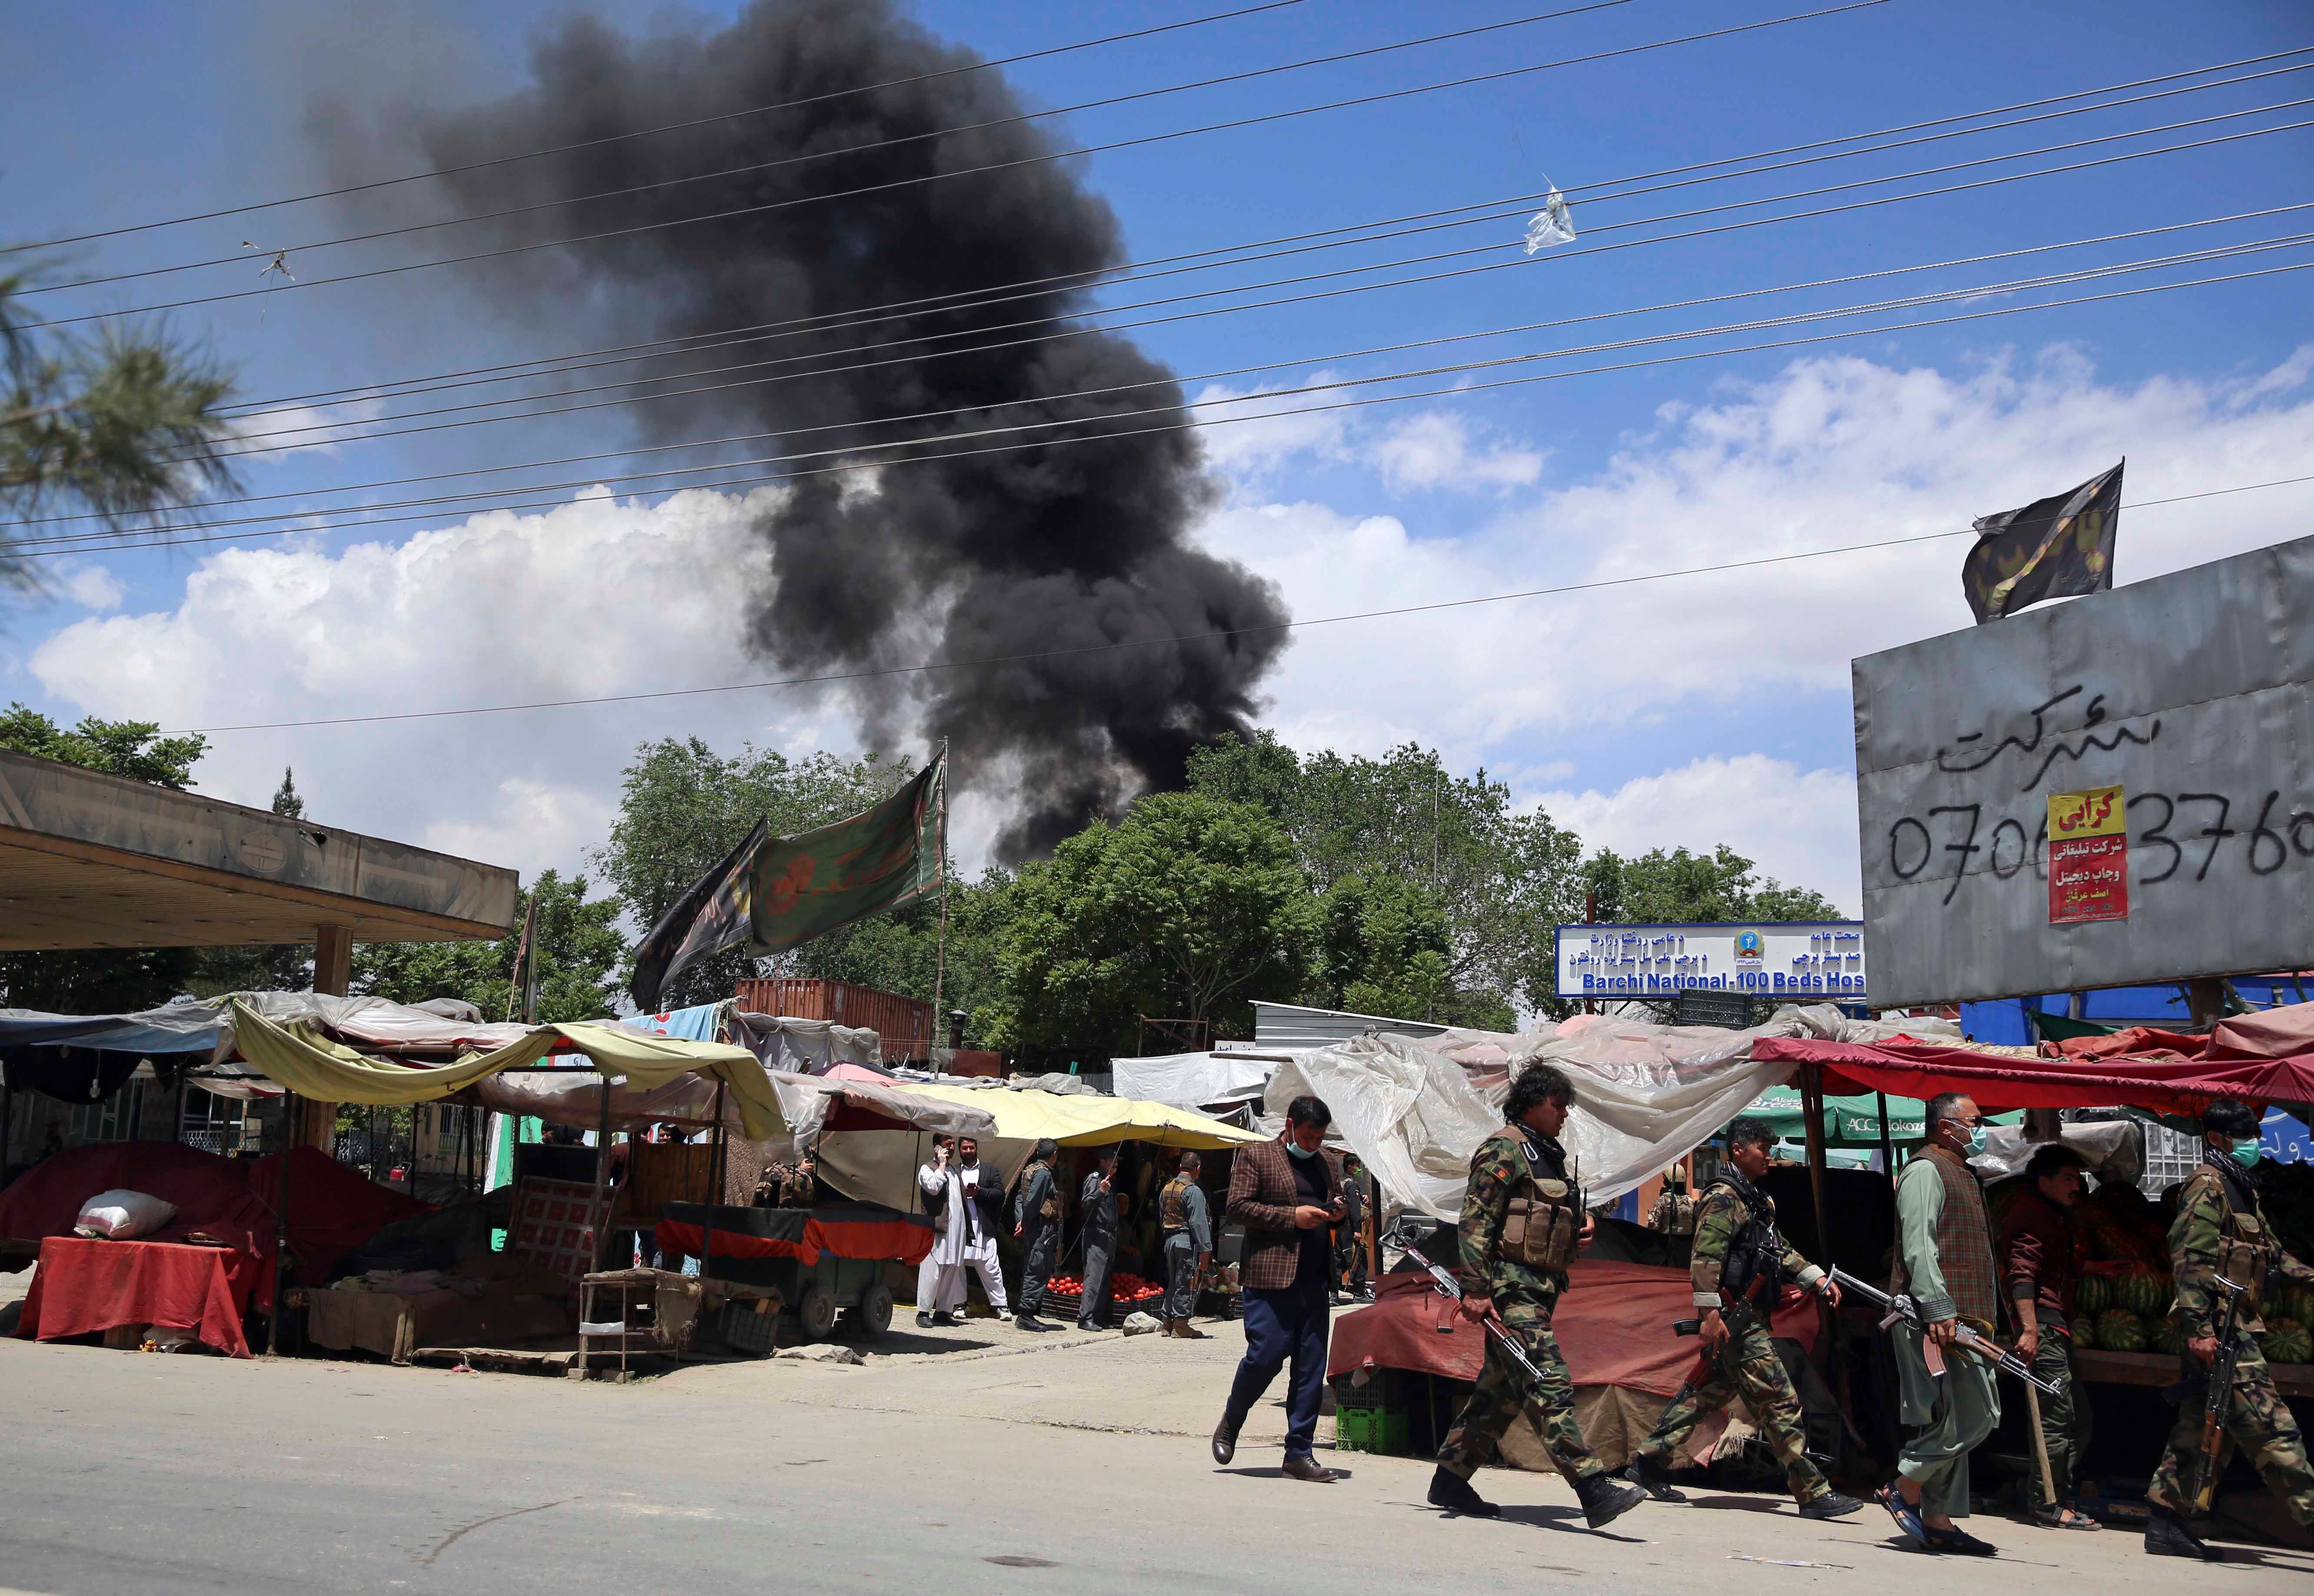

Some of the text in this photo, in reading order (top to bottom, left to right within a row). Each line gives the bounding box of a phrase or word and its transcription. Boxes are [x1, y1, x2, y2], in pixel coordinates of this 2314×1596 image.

[2053, 839, 2122, 861] شرکت تبلیغاتی
[2056, 871, 2090, 887] دیجیتل
[1590, 934, 1618, 946] وزارت
[1811, 930, 1860, 940] صحت عامه
[1569, 950, 1600, 966] روغتون
[1639, 953, 1652, 964] سل
[1792, 953, 1819, 968] برچی
[1822, 950, 1841, 965] بستر
[1583, 973, 1643, 989] Barchi
[1773, 972, 1822, 987] Beds
[1827, 972, 1864, 987] Hos
